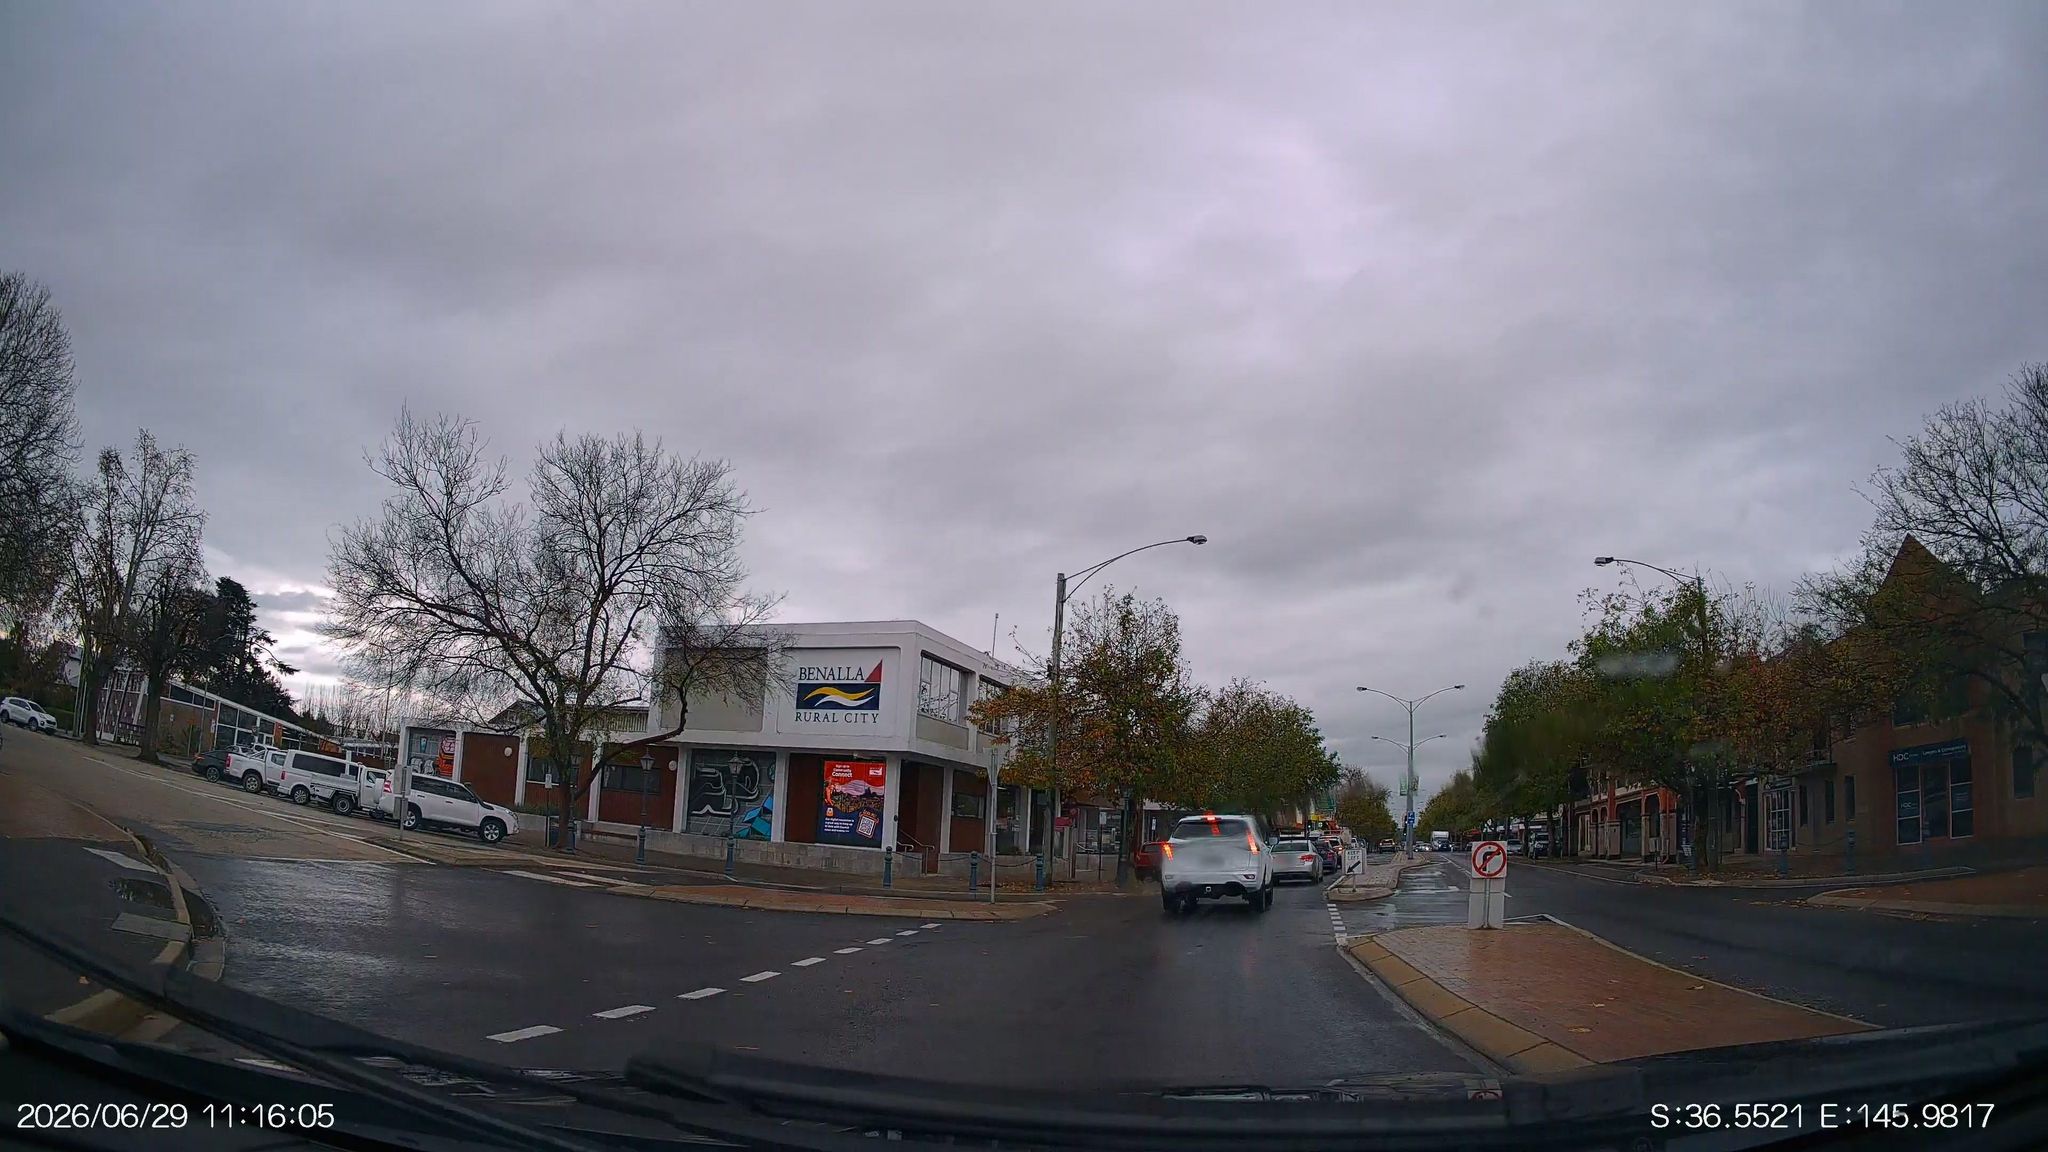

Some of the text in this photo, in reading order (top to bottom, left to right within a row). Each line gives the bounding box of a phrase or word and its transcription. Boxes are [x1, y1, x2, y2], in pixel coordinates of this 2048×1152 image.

[799, 666, 865, 681] BENALLA
[794, 711, 880, 724] RURAL CITY
